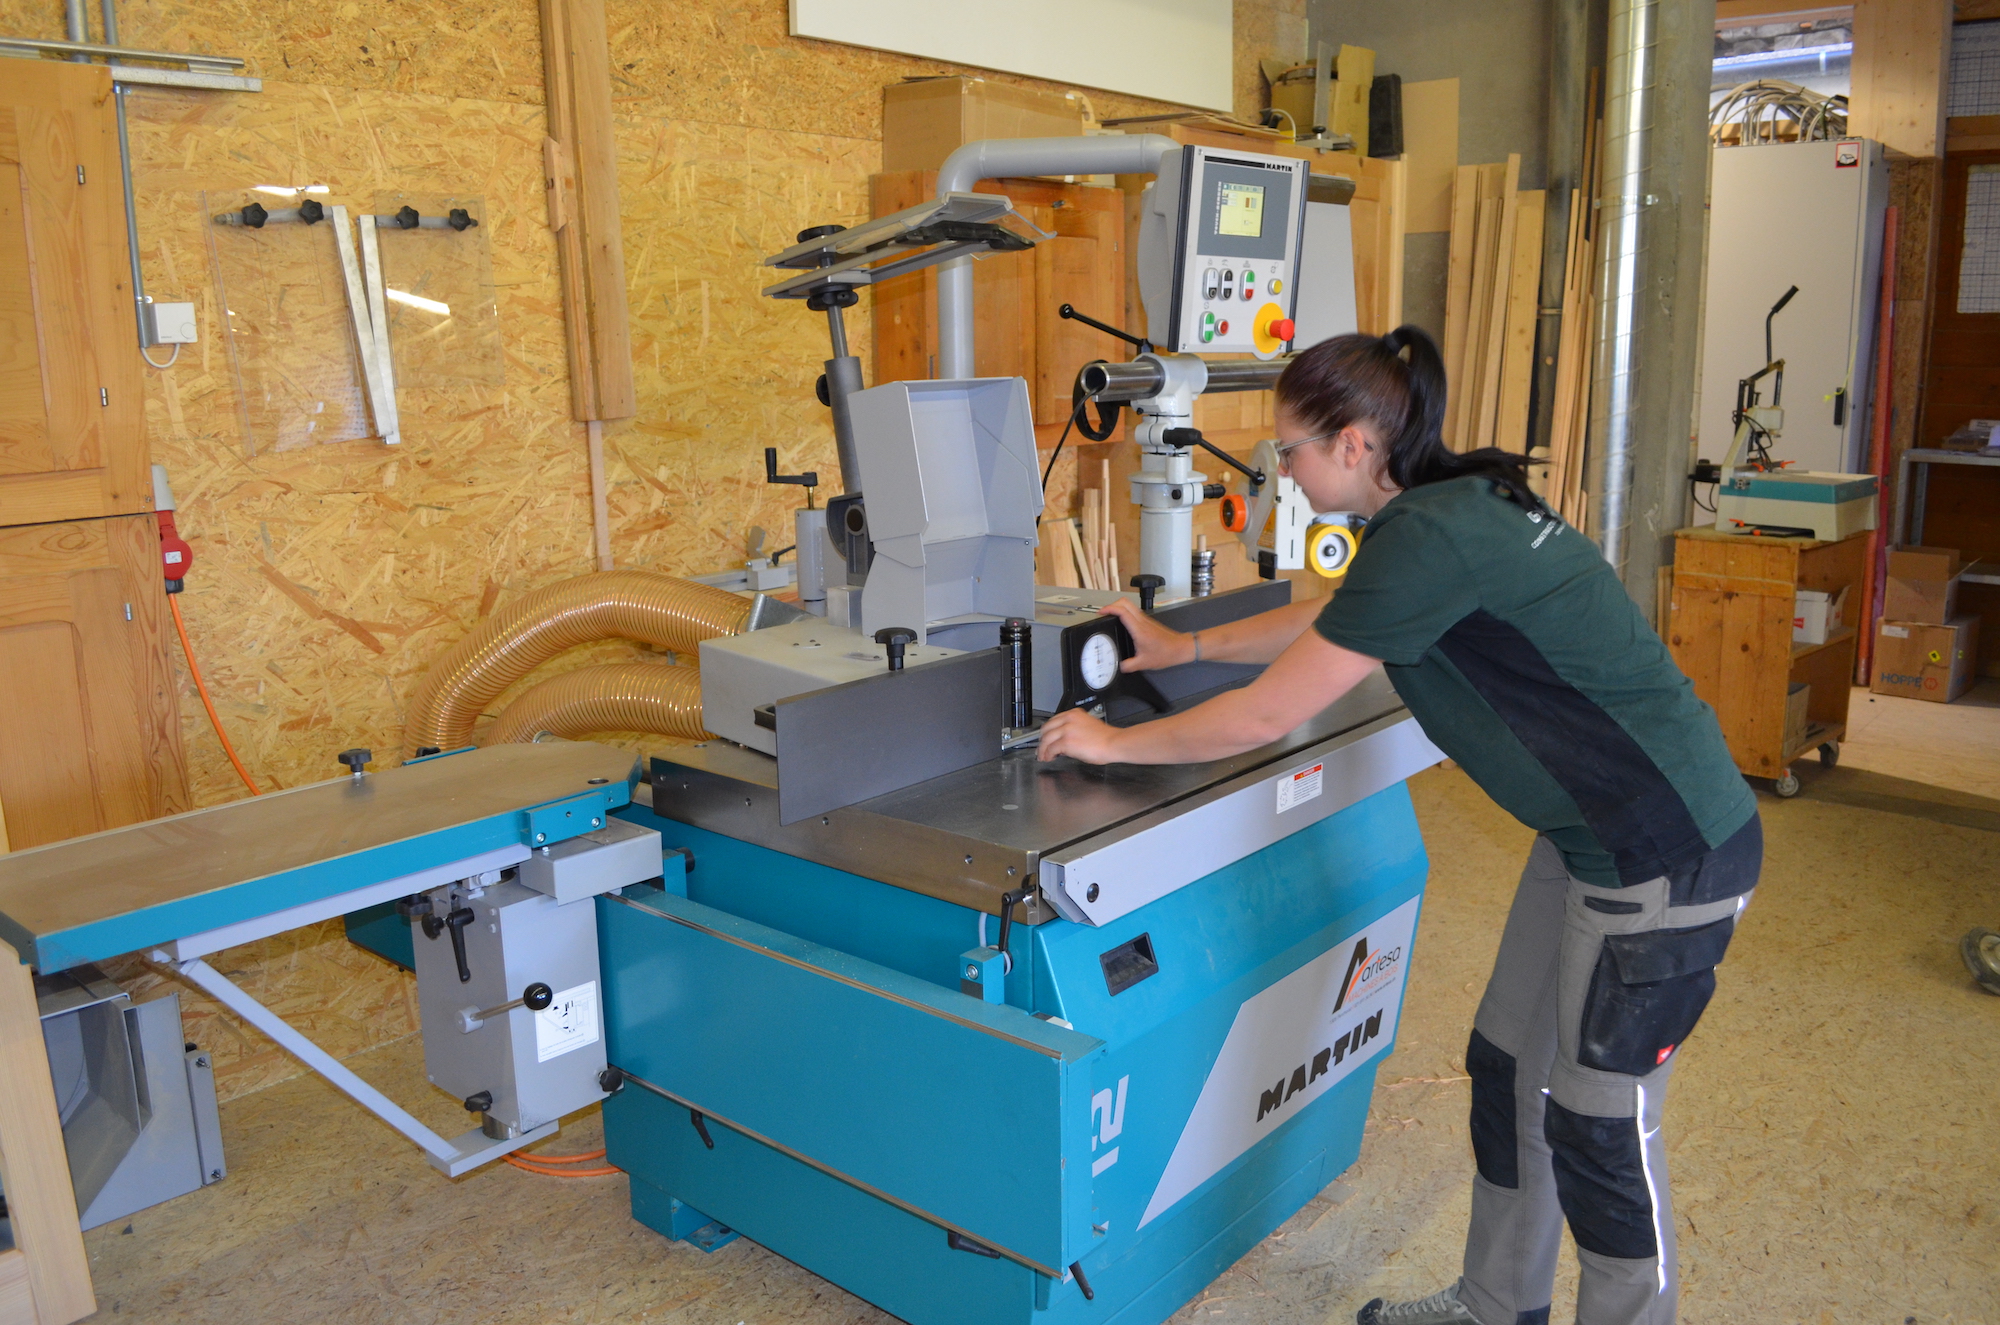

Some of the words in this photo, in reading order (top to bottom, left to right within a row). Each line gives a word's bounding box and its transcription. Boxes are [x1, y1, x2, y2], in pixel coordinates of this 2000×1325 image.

[1266, 163, 1293, 172] MARTIN
[1881, 673, 1923, 689] HOPPE
[1361, 946, 1401, 982] artesa
[1256, 1007, 1383, 1123] MARTIN
